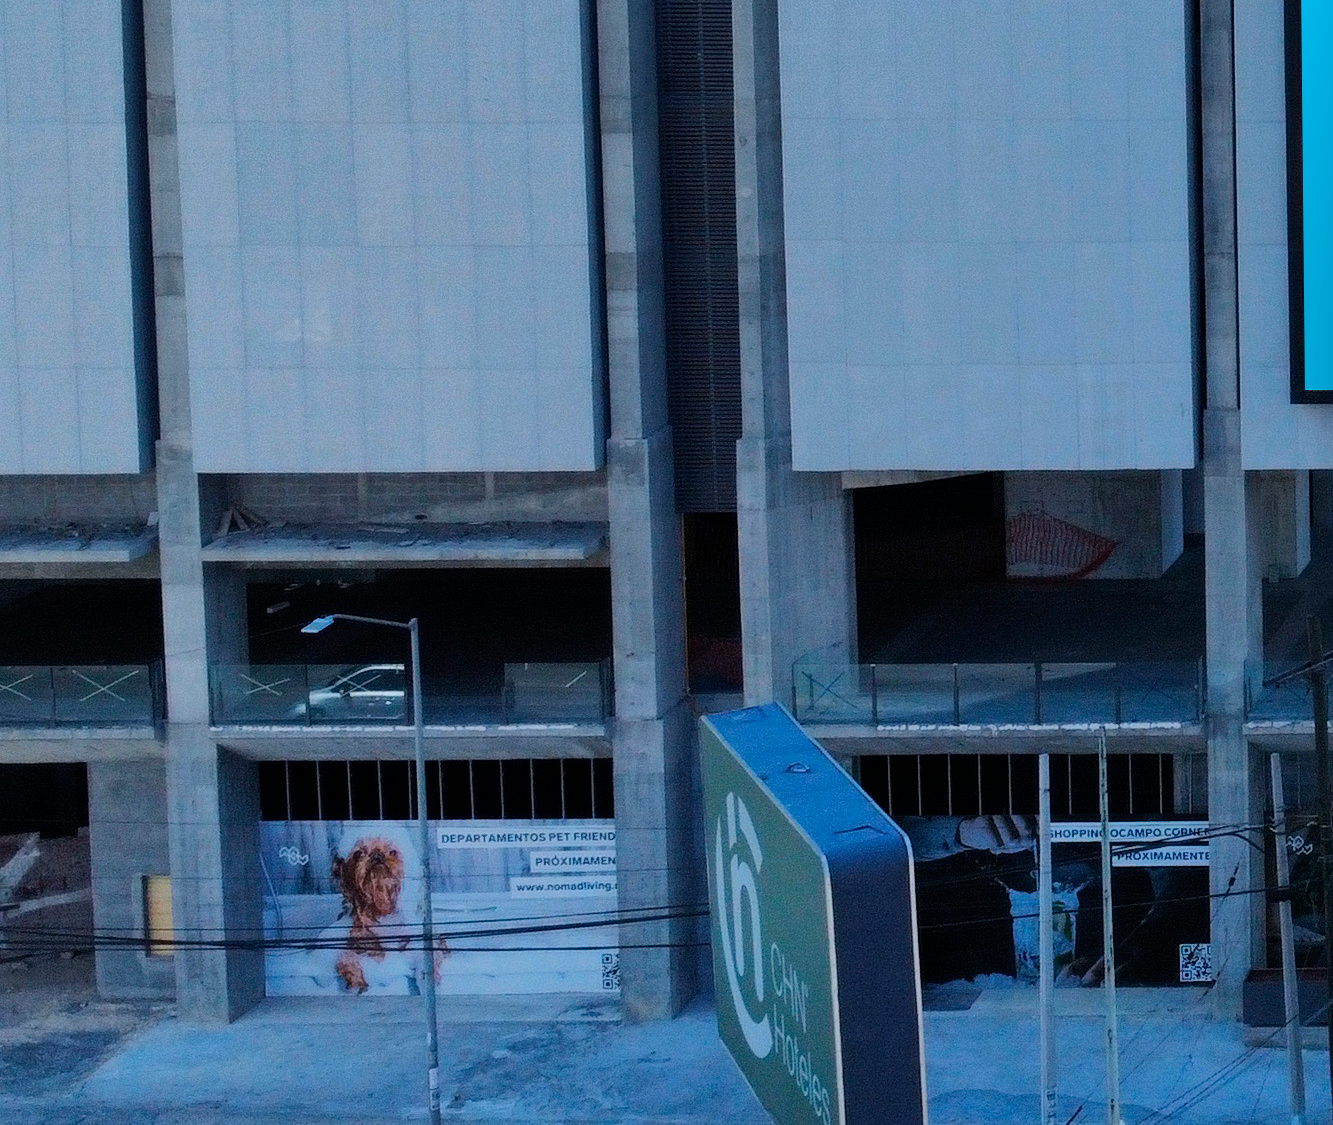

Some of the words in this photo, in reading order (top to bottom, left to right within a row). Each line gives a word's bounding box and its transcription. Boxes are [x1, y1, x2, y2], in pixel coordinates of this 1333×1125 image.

[441, 833, 547, 843] DEPARTAMENTOS
[549, 832, 570, 842] PET
[1110, 828, 1162, 838] OCAMPO
[774, 1003, 831, 1125] Hoteles
